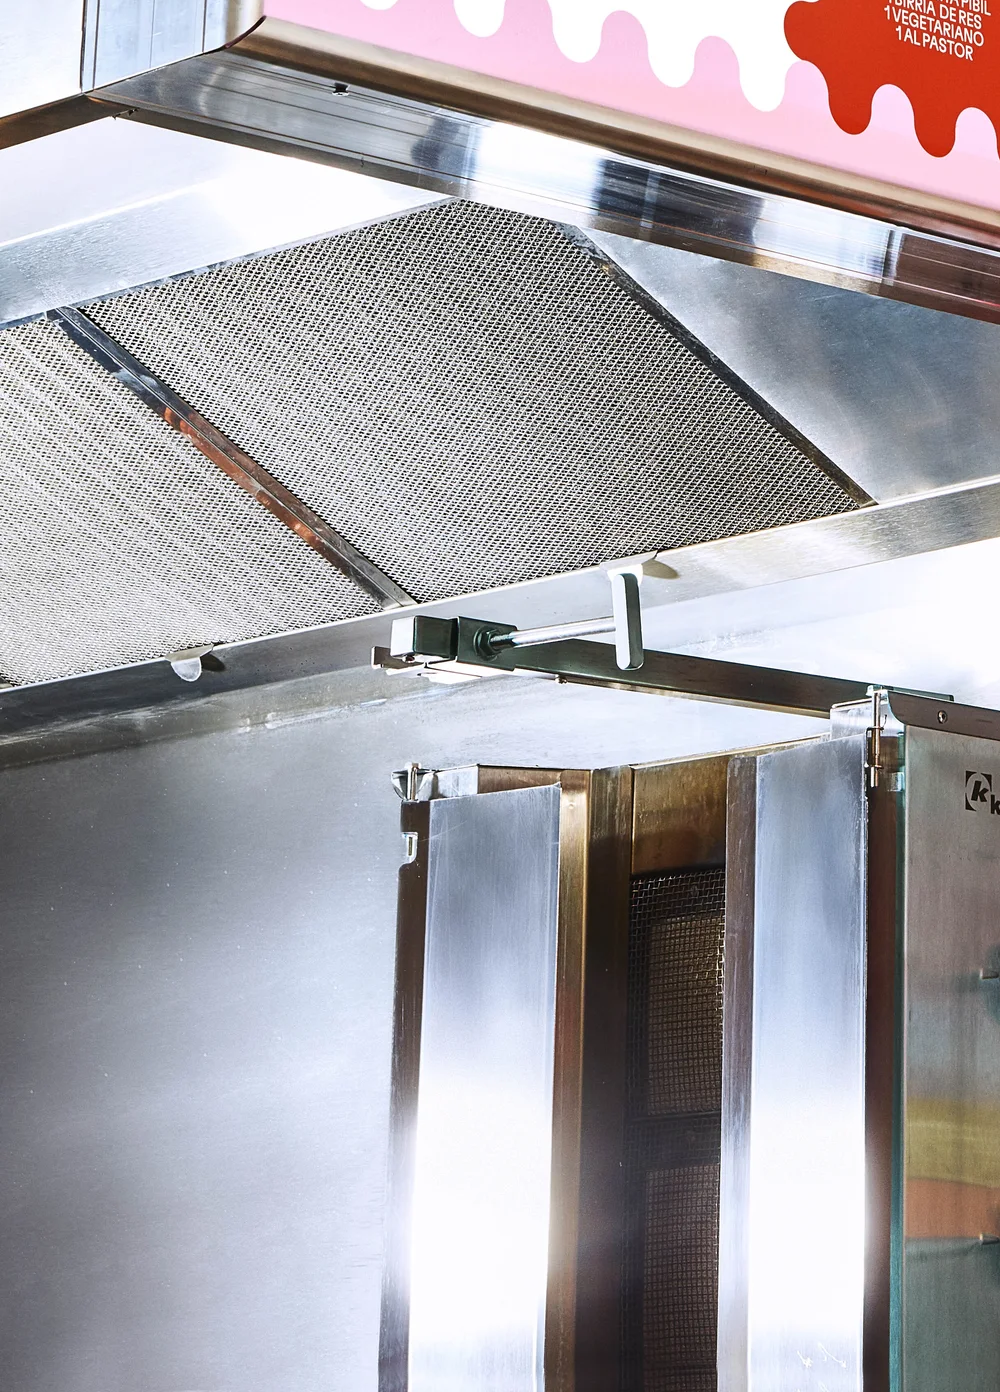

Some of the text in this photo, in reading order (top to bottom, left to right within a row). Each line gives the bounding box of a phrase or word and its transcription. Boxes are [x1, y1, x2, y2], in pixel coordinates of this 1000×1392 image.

[884, 5, 984, 46] 1 VEGETARIANO
[896, 26, 973, 61] 1 AL PASTOR
